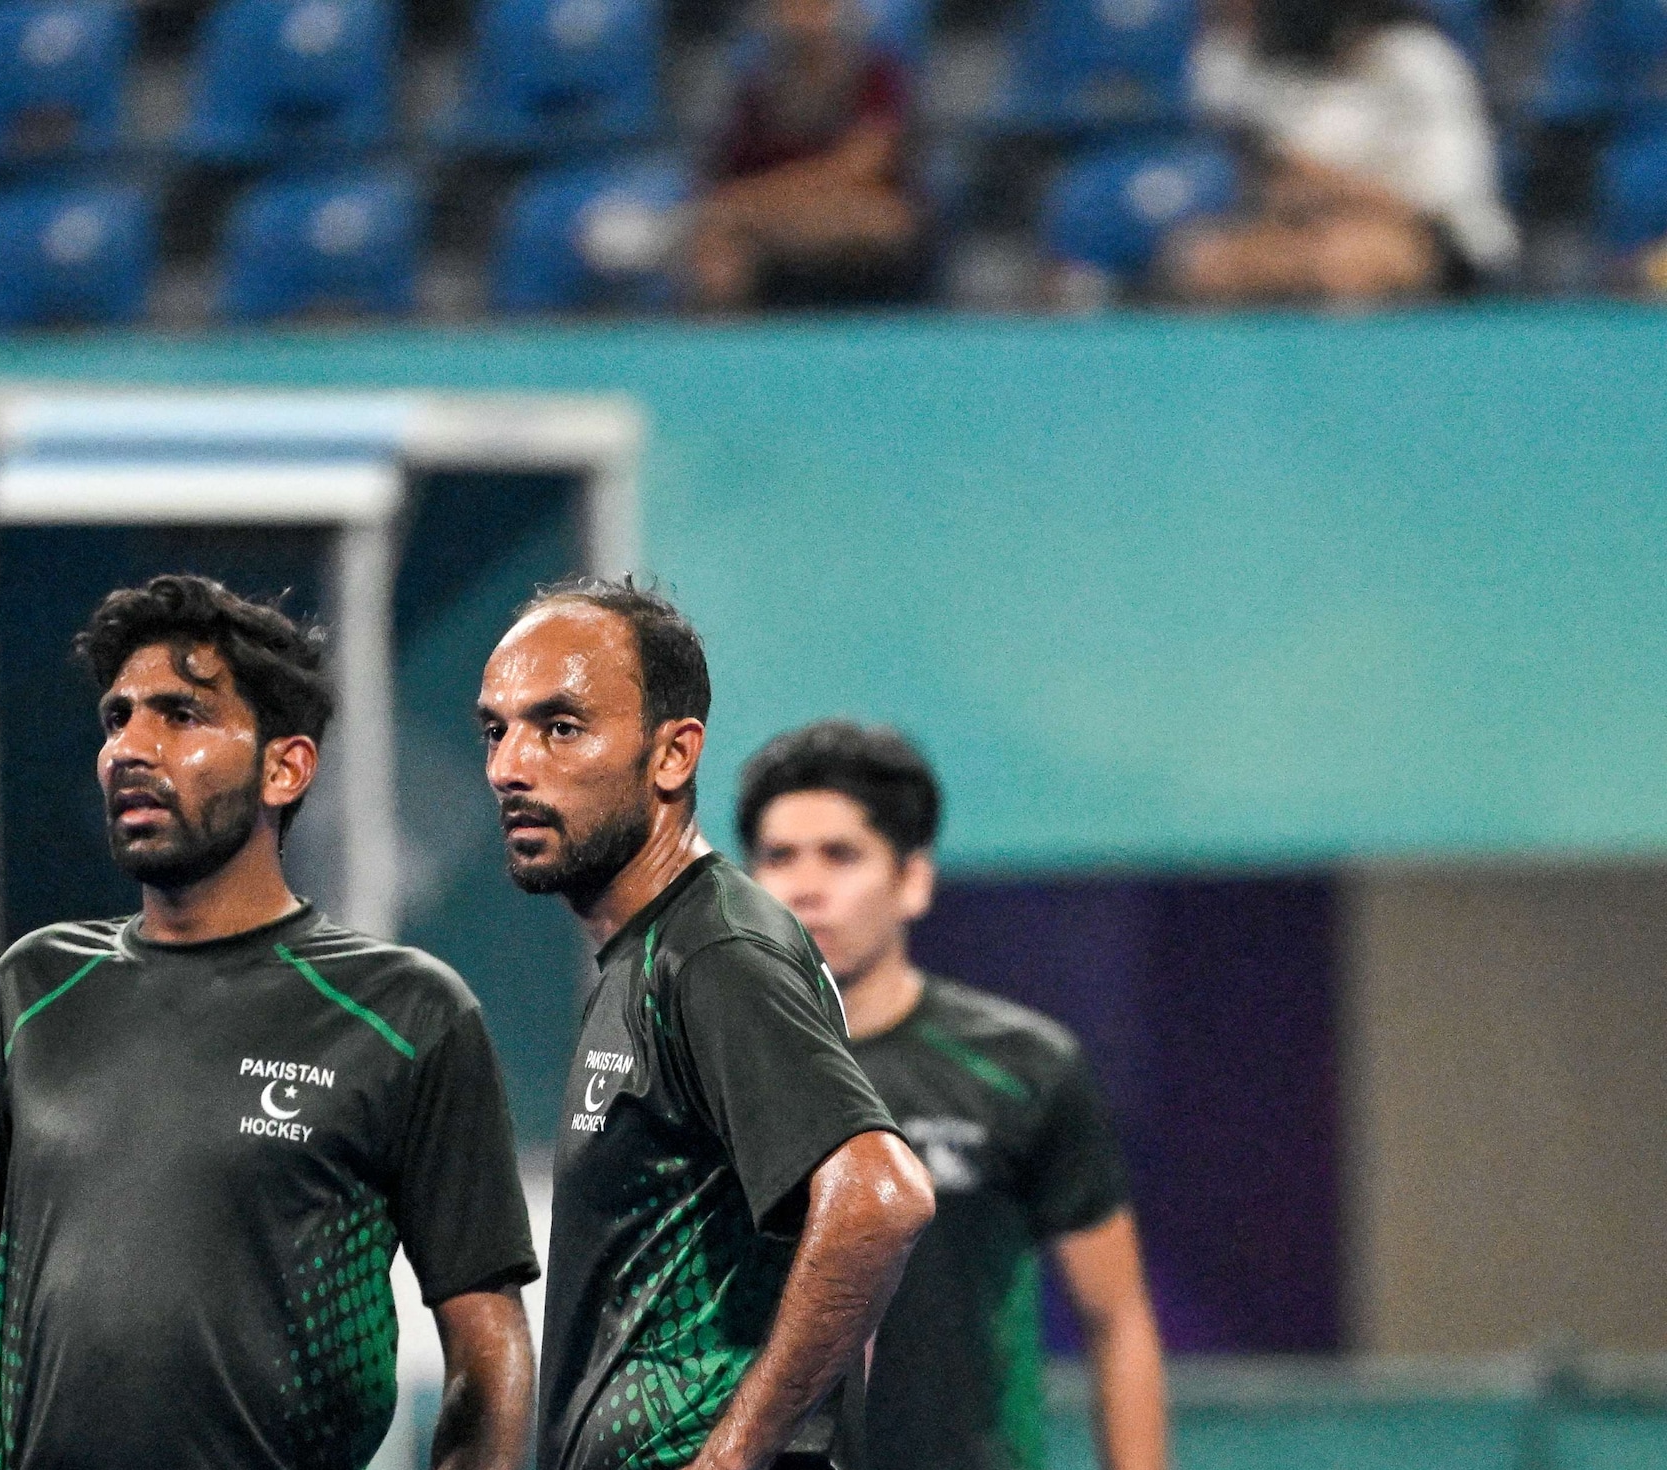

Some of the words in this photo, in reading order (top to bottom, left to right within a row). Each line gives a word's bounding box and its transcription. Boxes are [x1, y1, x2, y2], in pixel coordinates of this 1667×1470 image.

[239, 1057, 335, 1088] PAKISTAN
[584, 1050, 634, 1074] PAKISTAN
[239, 1116, 313, 1143] HOCKEY
[571, 1113, 607, 1132] HOCKEY
